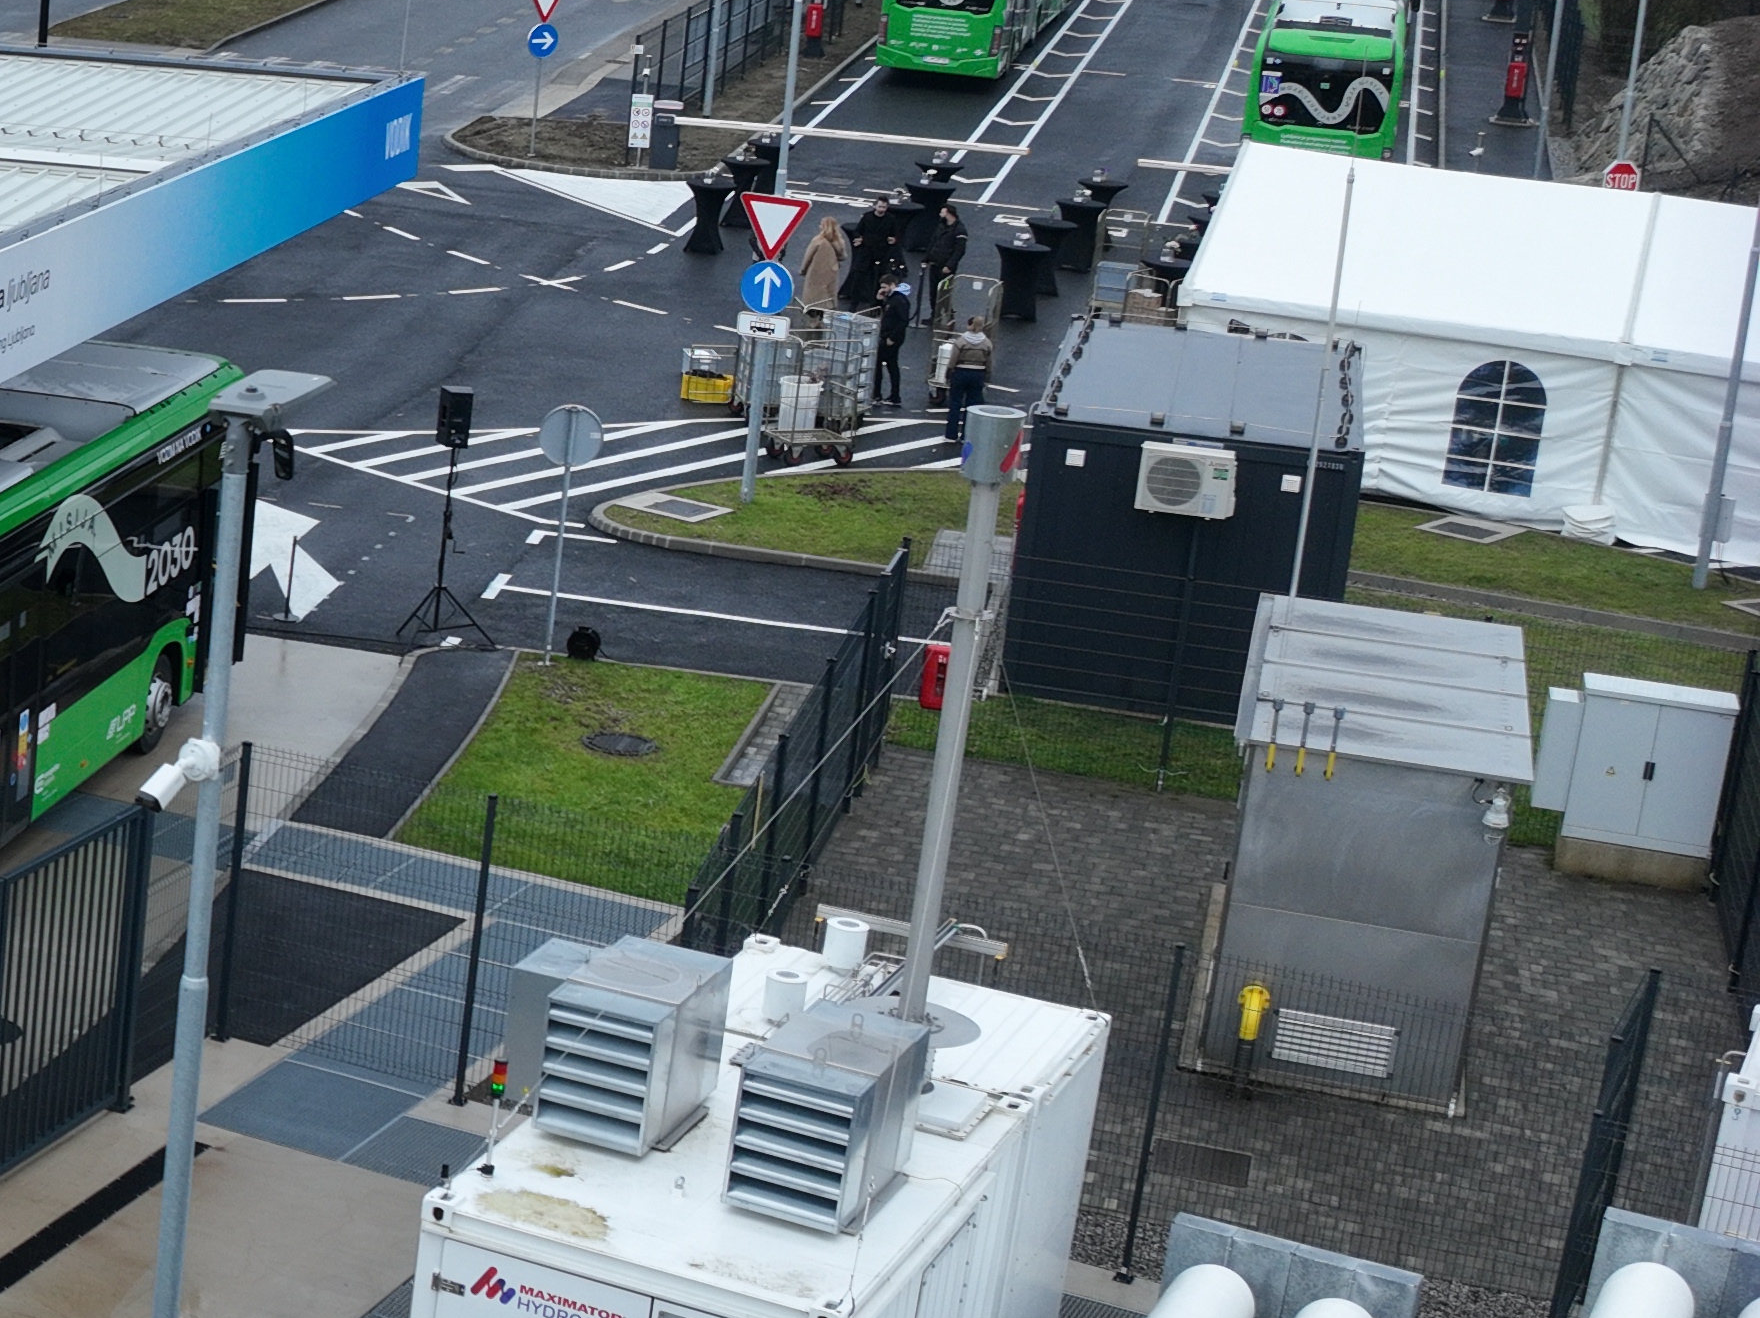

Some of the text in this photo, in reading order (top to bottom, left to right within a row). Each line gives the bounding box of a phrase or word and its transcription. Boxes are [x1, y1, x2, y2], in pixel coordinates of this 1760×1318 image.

[1605, 173, 1637, 189] STOP
[7, 269, 50, 313] ljubljana
[146, 525, 195, 596] 2030
